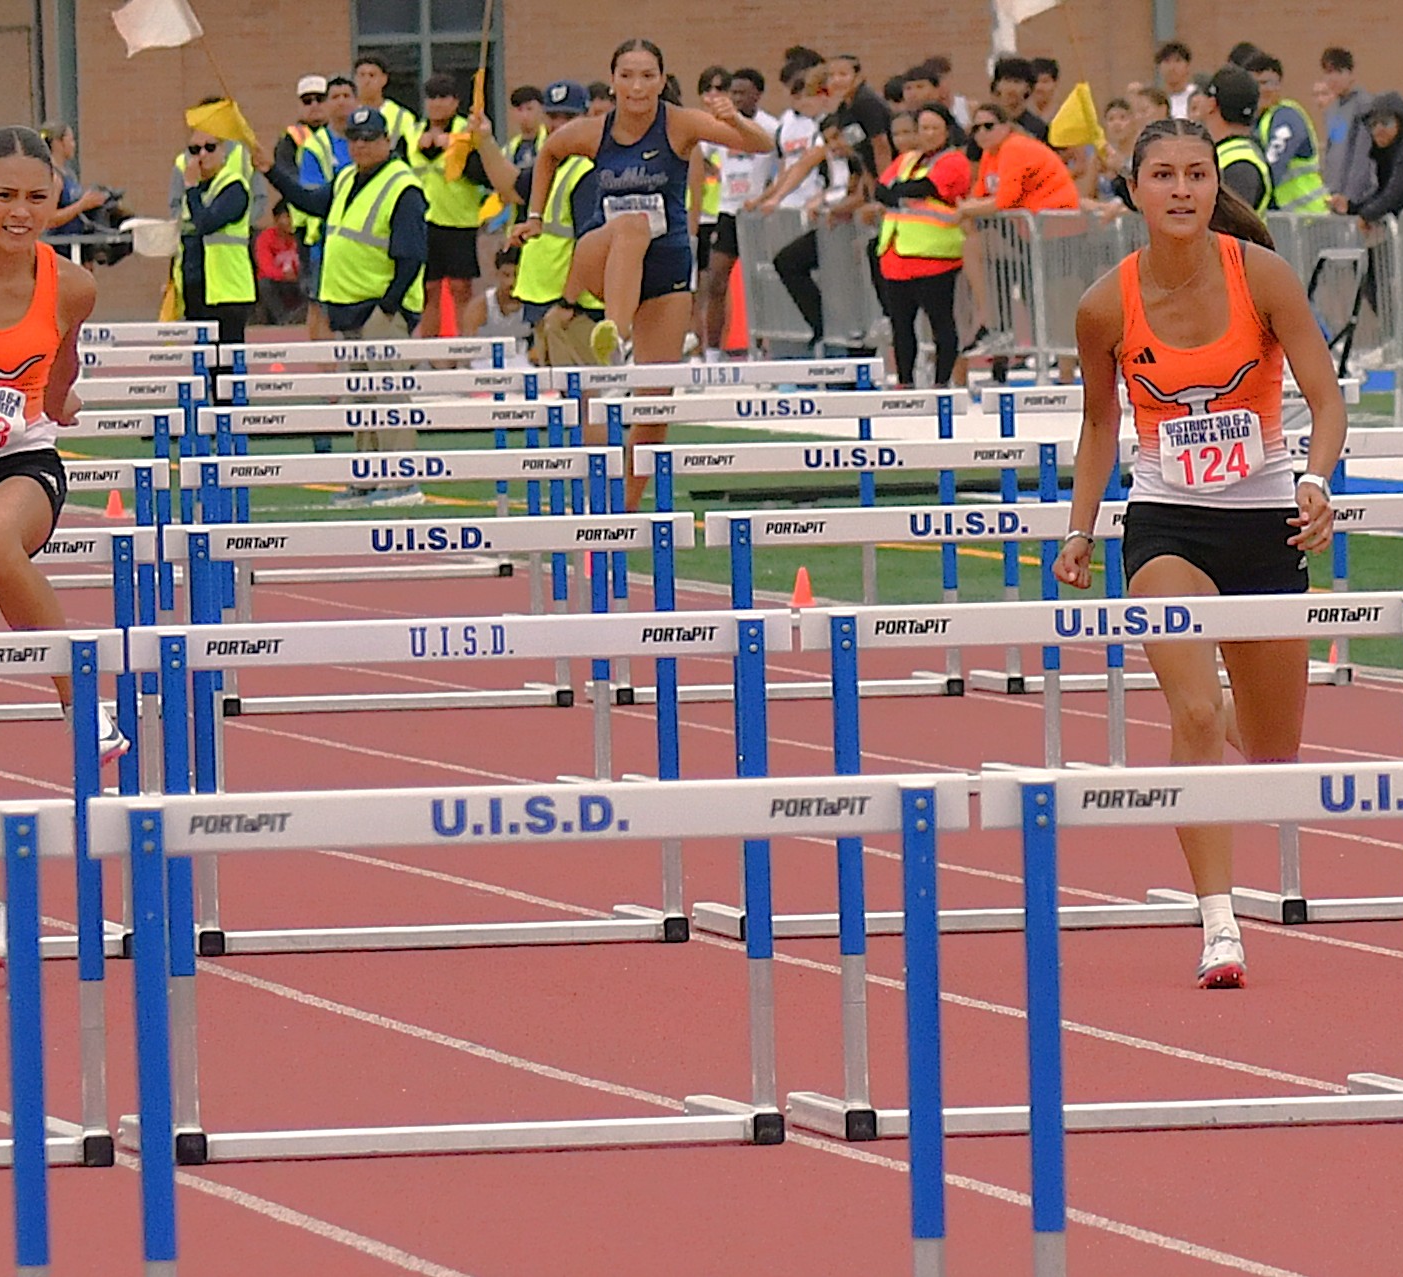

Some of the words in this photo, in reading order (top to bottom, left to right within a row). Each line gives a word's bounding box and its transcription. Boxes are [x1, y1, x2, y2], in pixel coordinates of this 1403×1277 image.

[333, 345, 401, 361] U.I.S.D.
[346, 376, 421, 392] U.I.S.D.
[346, 409, 432, 427] U.I.S.D.
[736, 399, 822, 417] U.I.S.D.
[1167, 418, 1214, 434] DISTRICT
[1217, 415, 1230, 428] 30
[1171, 432, 1207, 447] TRACK
[1210, 432, 1217, 442] &
[1221, 426, 1249, 440] FIELD
[352, 457, 452, 479] U.I.S.D.
[804, 447, 903, 468] U.I.S.D.
[1177, 442, 1249, 485] 124
[909, 511, 1029, 537] U.I.S.D.
[371, 526, 492, 552] U.I.S.D.
[1054, 605, 1202, 638] U.I.S.D.
[409, 624, 514, 658] U.I.S.D.
[431, 795, 629, 838] U.I.S.D.
